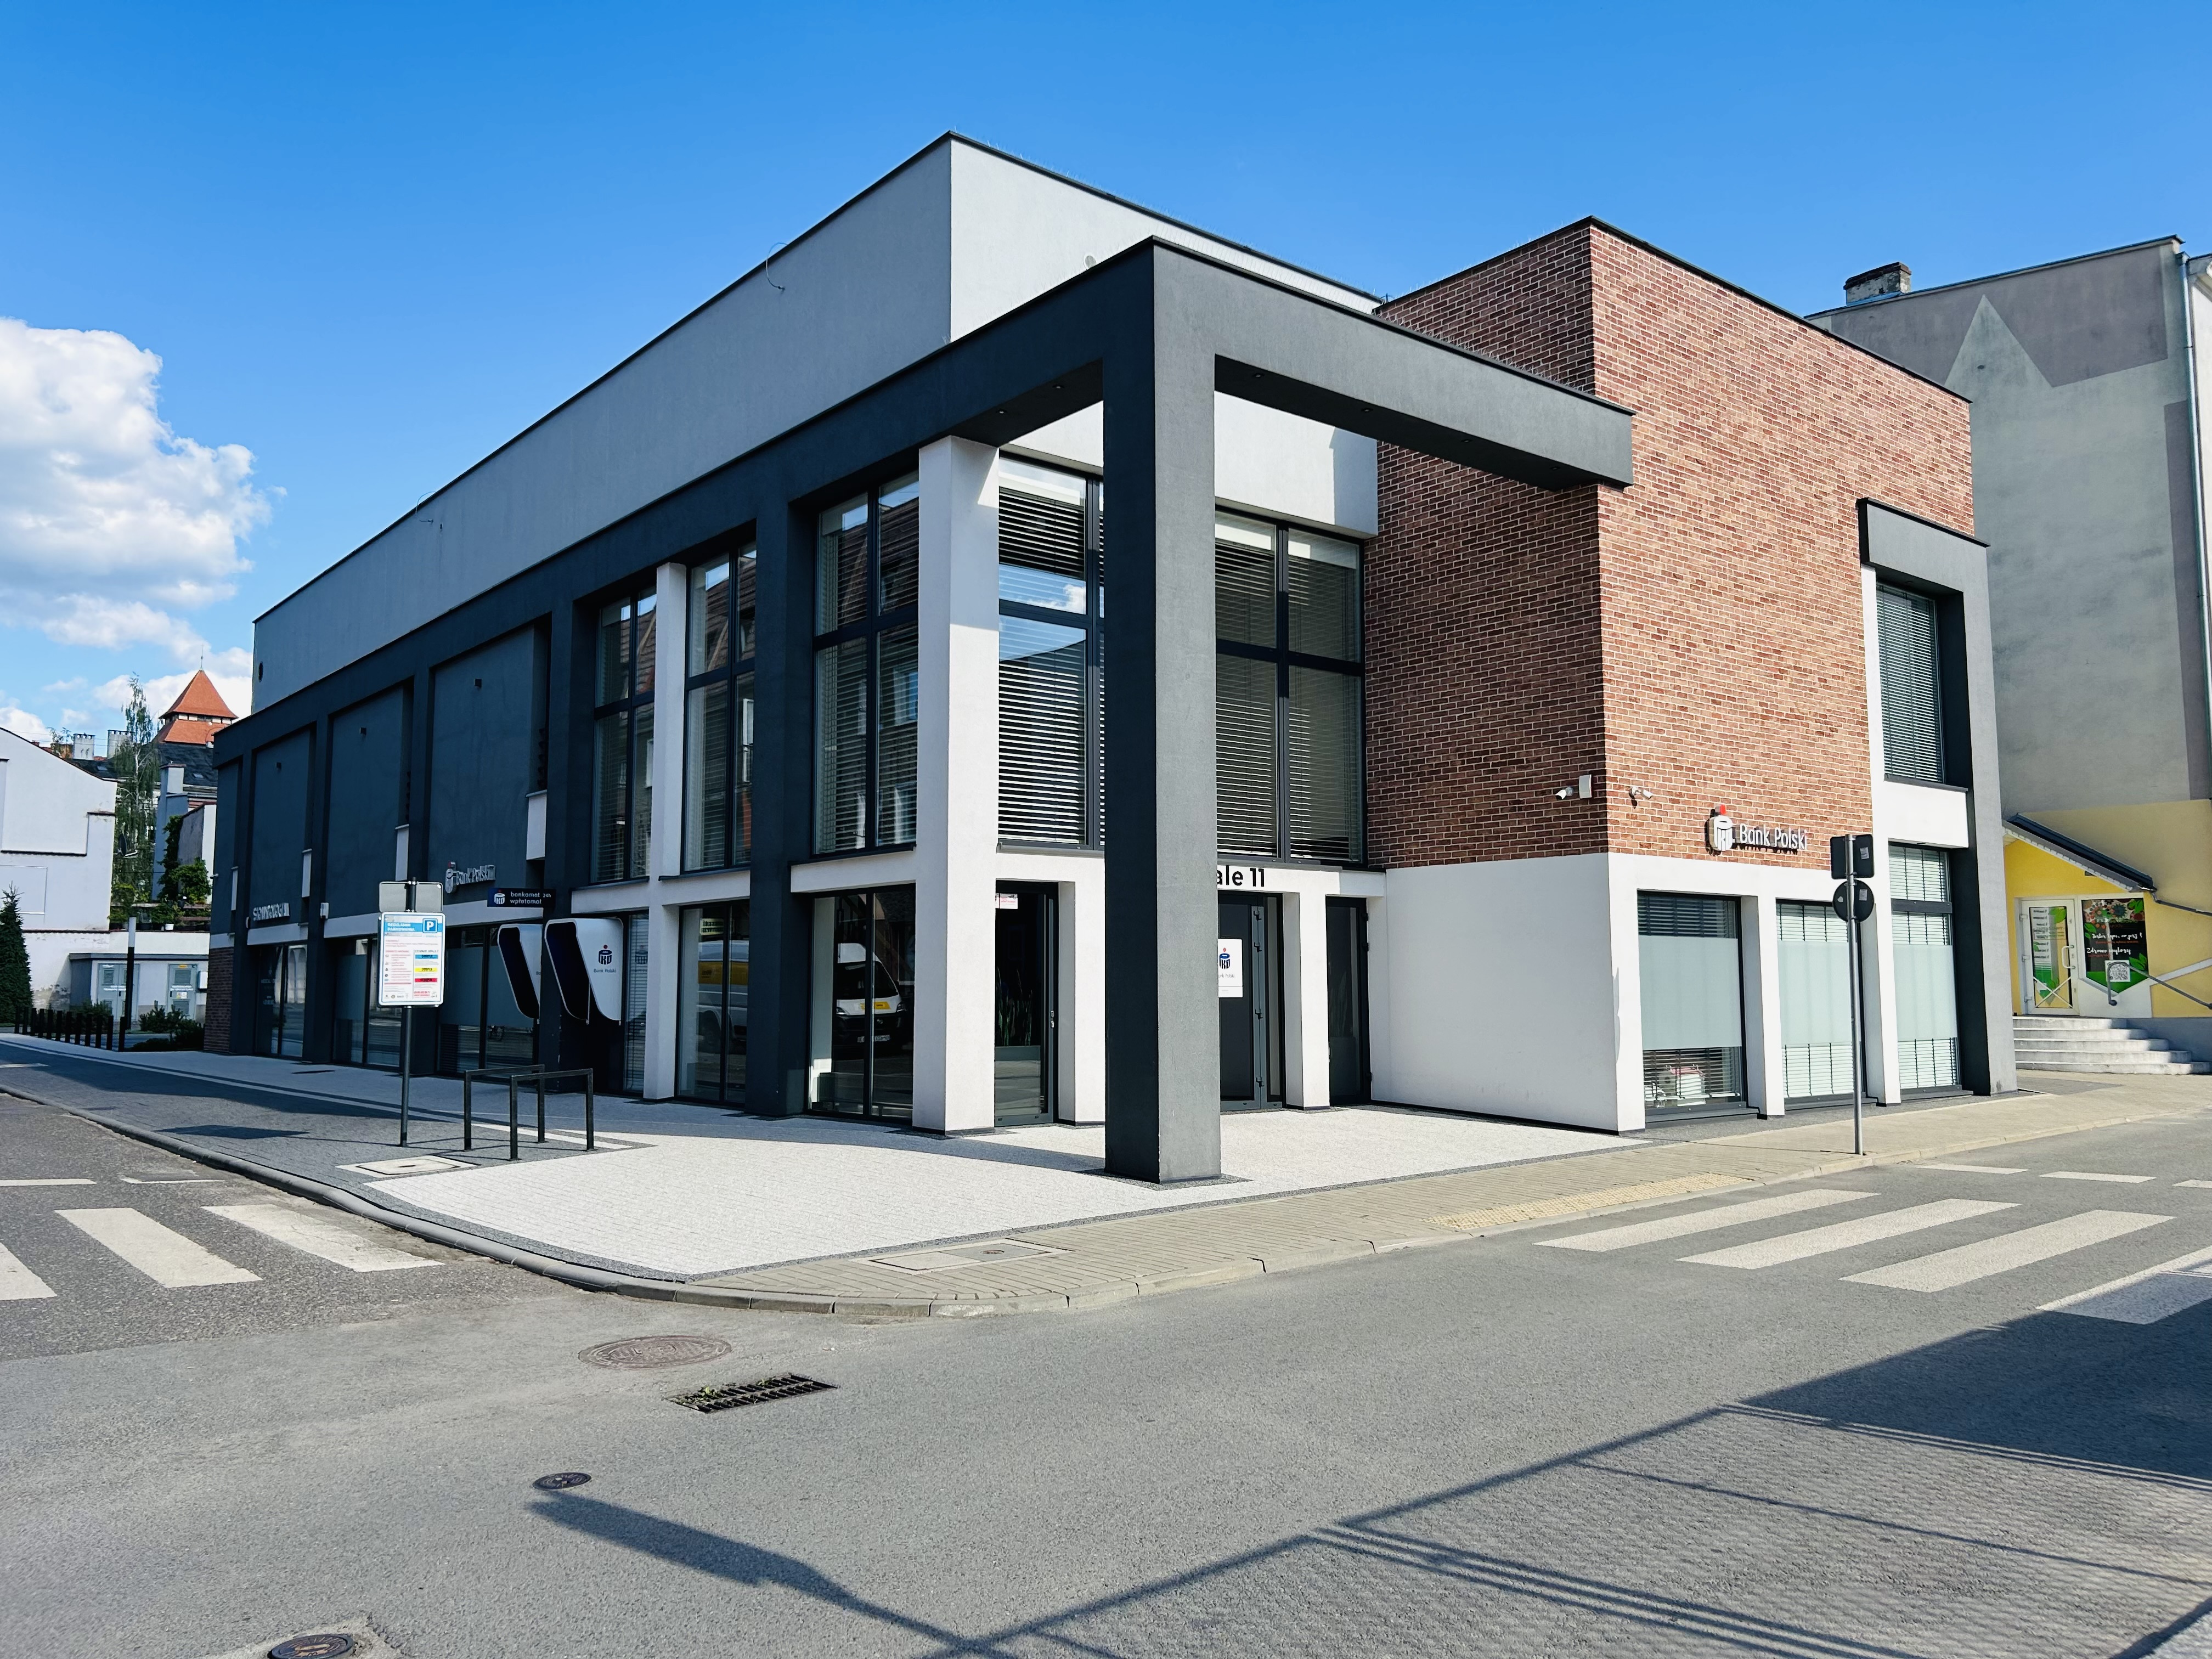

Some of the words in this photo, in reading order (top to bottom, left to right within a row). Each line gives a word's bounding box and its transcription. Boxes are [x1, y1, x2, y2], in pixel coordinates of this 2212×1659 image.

[1740, 823, 1770, 846] Bank
[1775, 827, 1808, 850] Polski
[1250, 868, 1265, 887] 11
[426, 921, 434, 931] P
